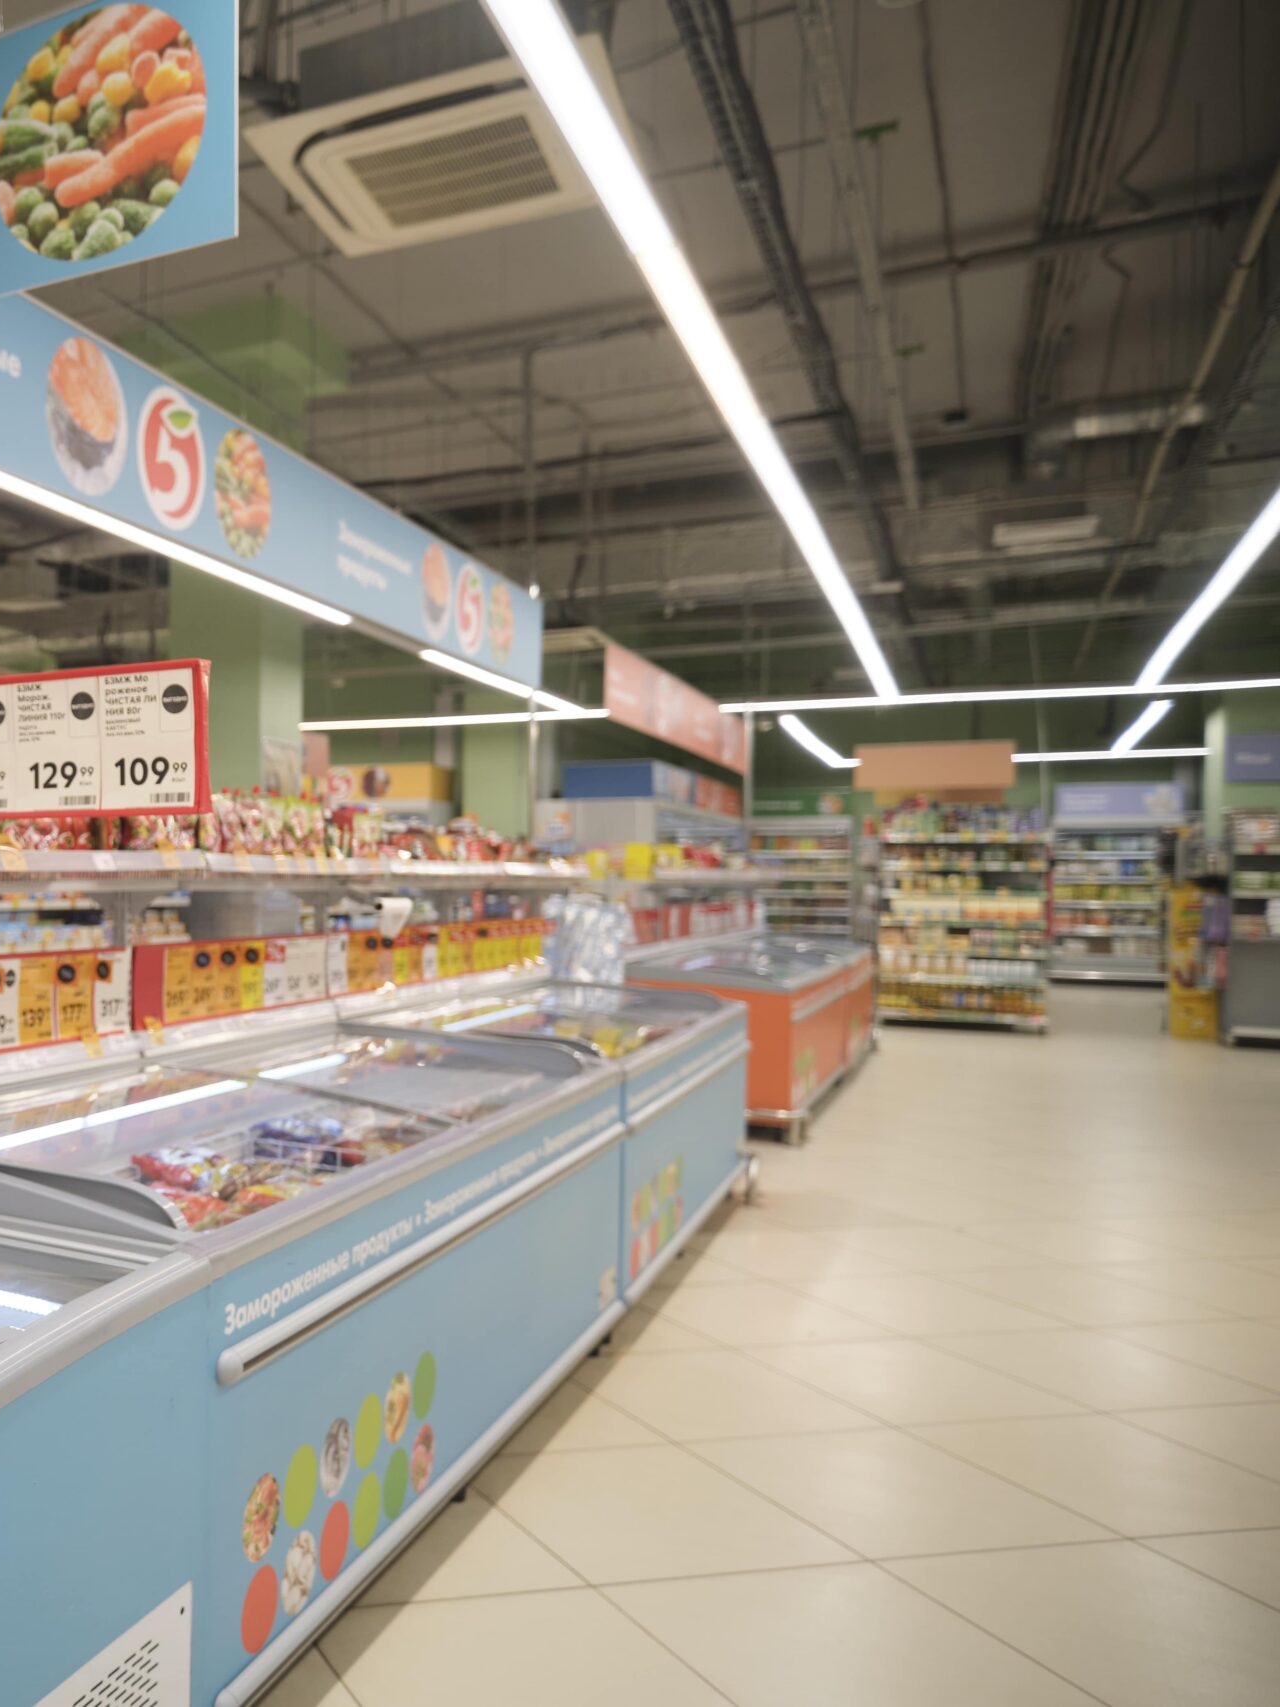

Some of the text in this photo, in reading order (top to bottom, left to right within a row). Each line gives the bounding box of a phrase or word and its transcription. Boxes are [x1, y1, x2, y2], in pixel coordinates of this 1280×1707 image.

[30, 761, 94, 789] 129 99
[115, 756, 187, 786] 109 99
[224, 1246, 349, 1335] Замороженные
[352, 1214, 413, 1267] продукты
